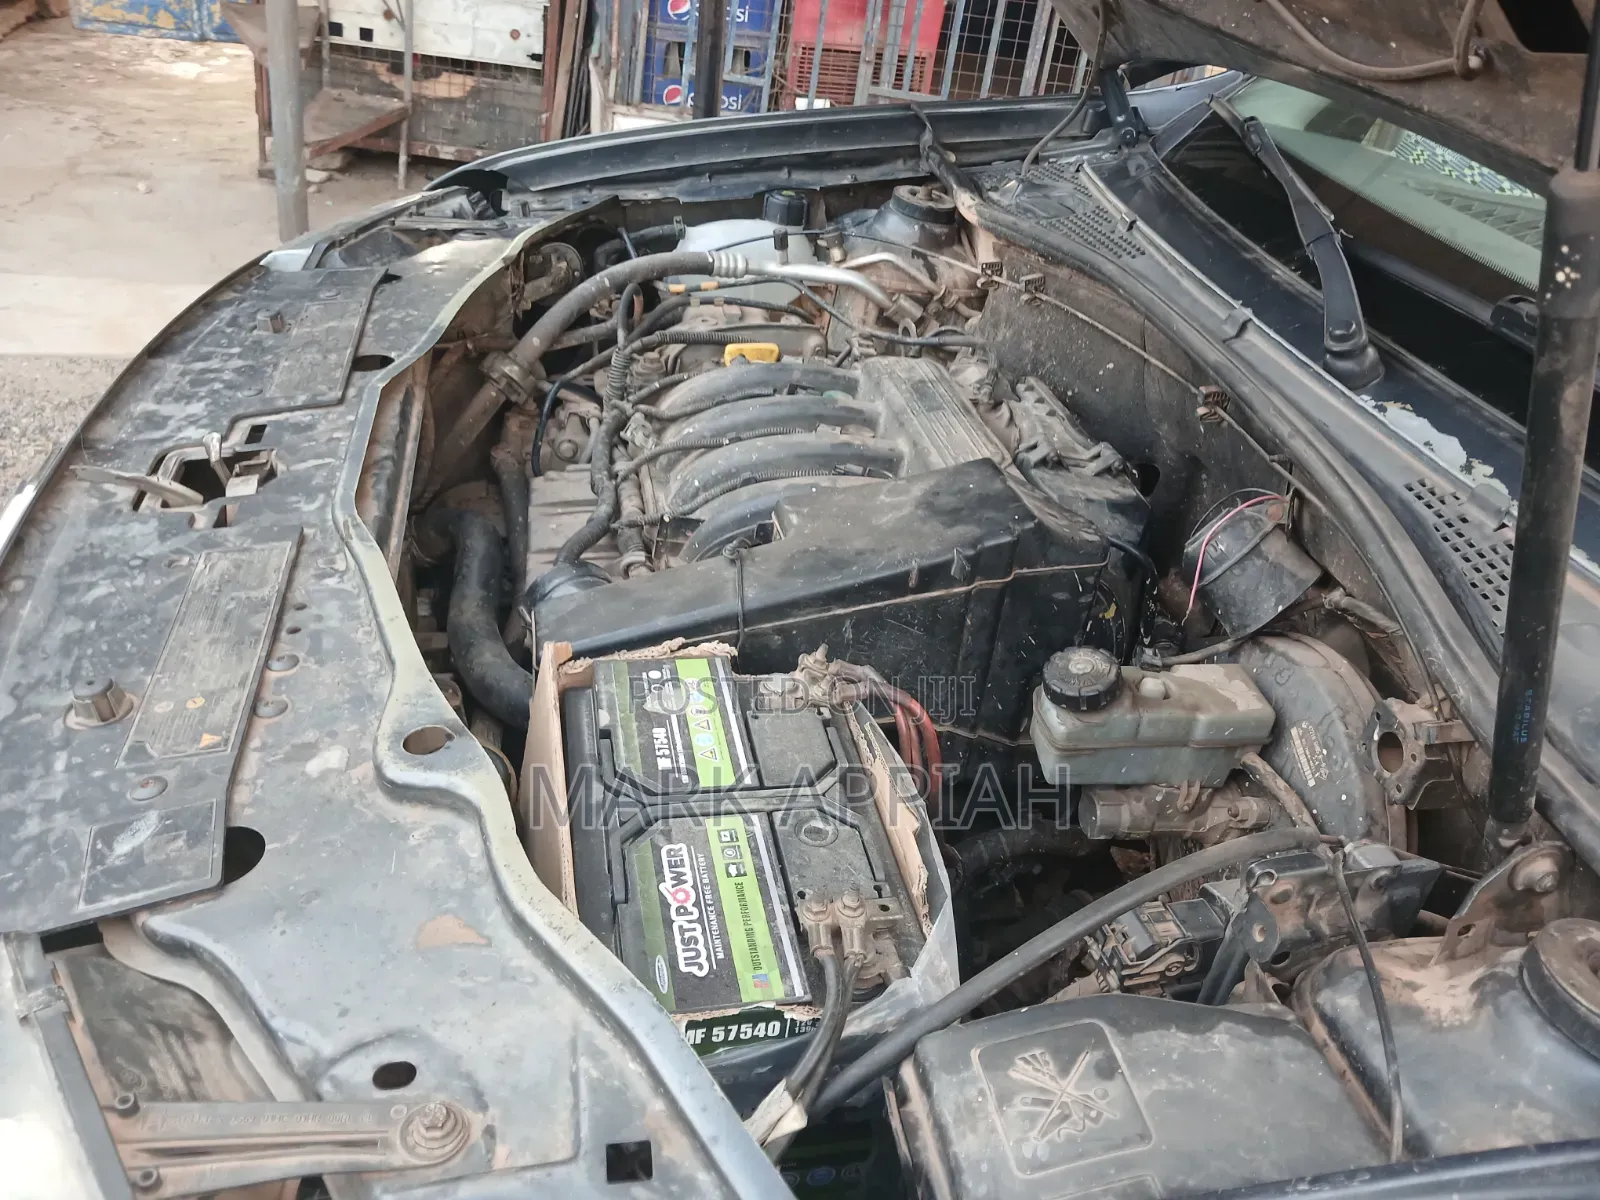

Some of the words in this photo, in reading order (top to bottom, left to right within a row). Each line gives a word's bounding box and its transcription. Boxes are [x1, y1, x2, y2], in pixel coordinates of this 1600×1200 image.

[651, 727, 671, 756] 57540
[662, 845, 696, 918] POWER
[697, 853, 711, 884] BATTERY
[702, 884, 716, 904] FREE
[734, 881, 753, 926] PERFORMANCE
[677, 923, 707, 973] JUST
[707, 905, 725, 960] MAINTENANCE
[744, 927, 762, 971] OUTSTANDING
[711, 1020, 781, 1043] 57540
